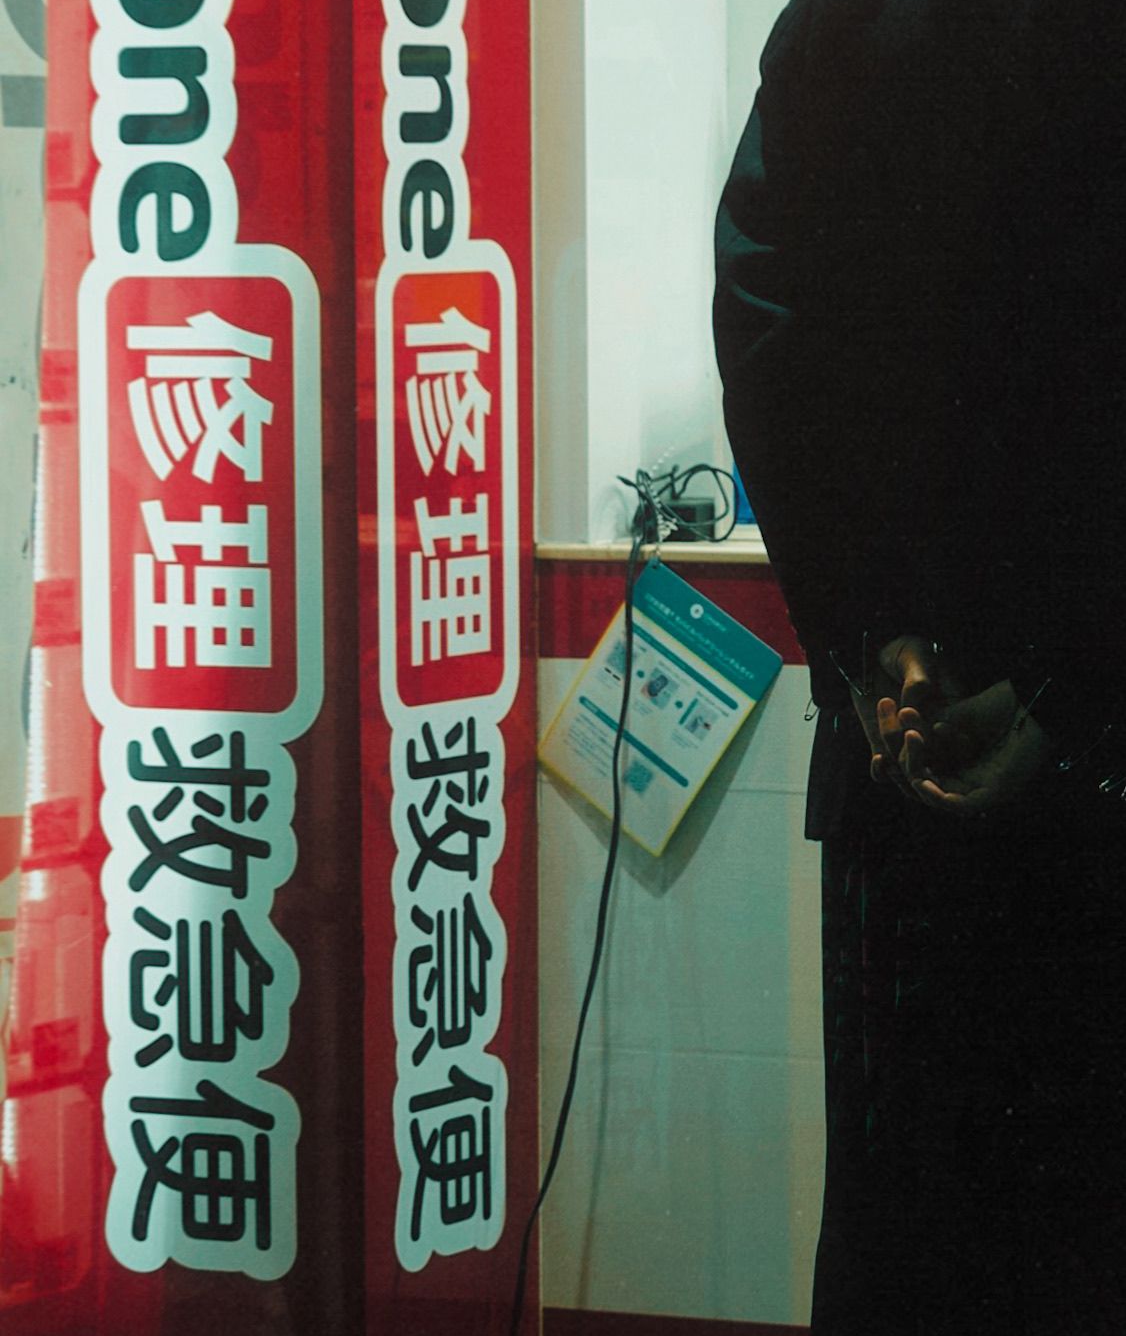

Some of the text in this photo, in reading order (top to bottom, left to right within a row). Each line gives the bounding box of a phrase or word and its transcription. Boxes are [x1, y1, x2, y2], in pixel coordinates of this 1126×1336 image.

[126, 310, 274, 670] 修理
[403, 306, 492, 668] 修理
[126, 725, 275, 1252] 救急便
[406, 714, 495, 1243] 救急便
